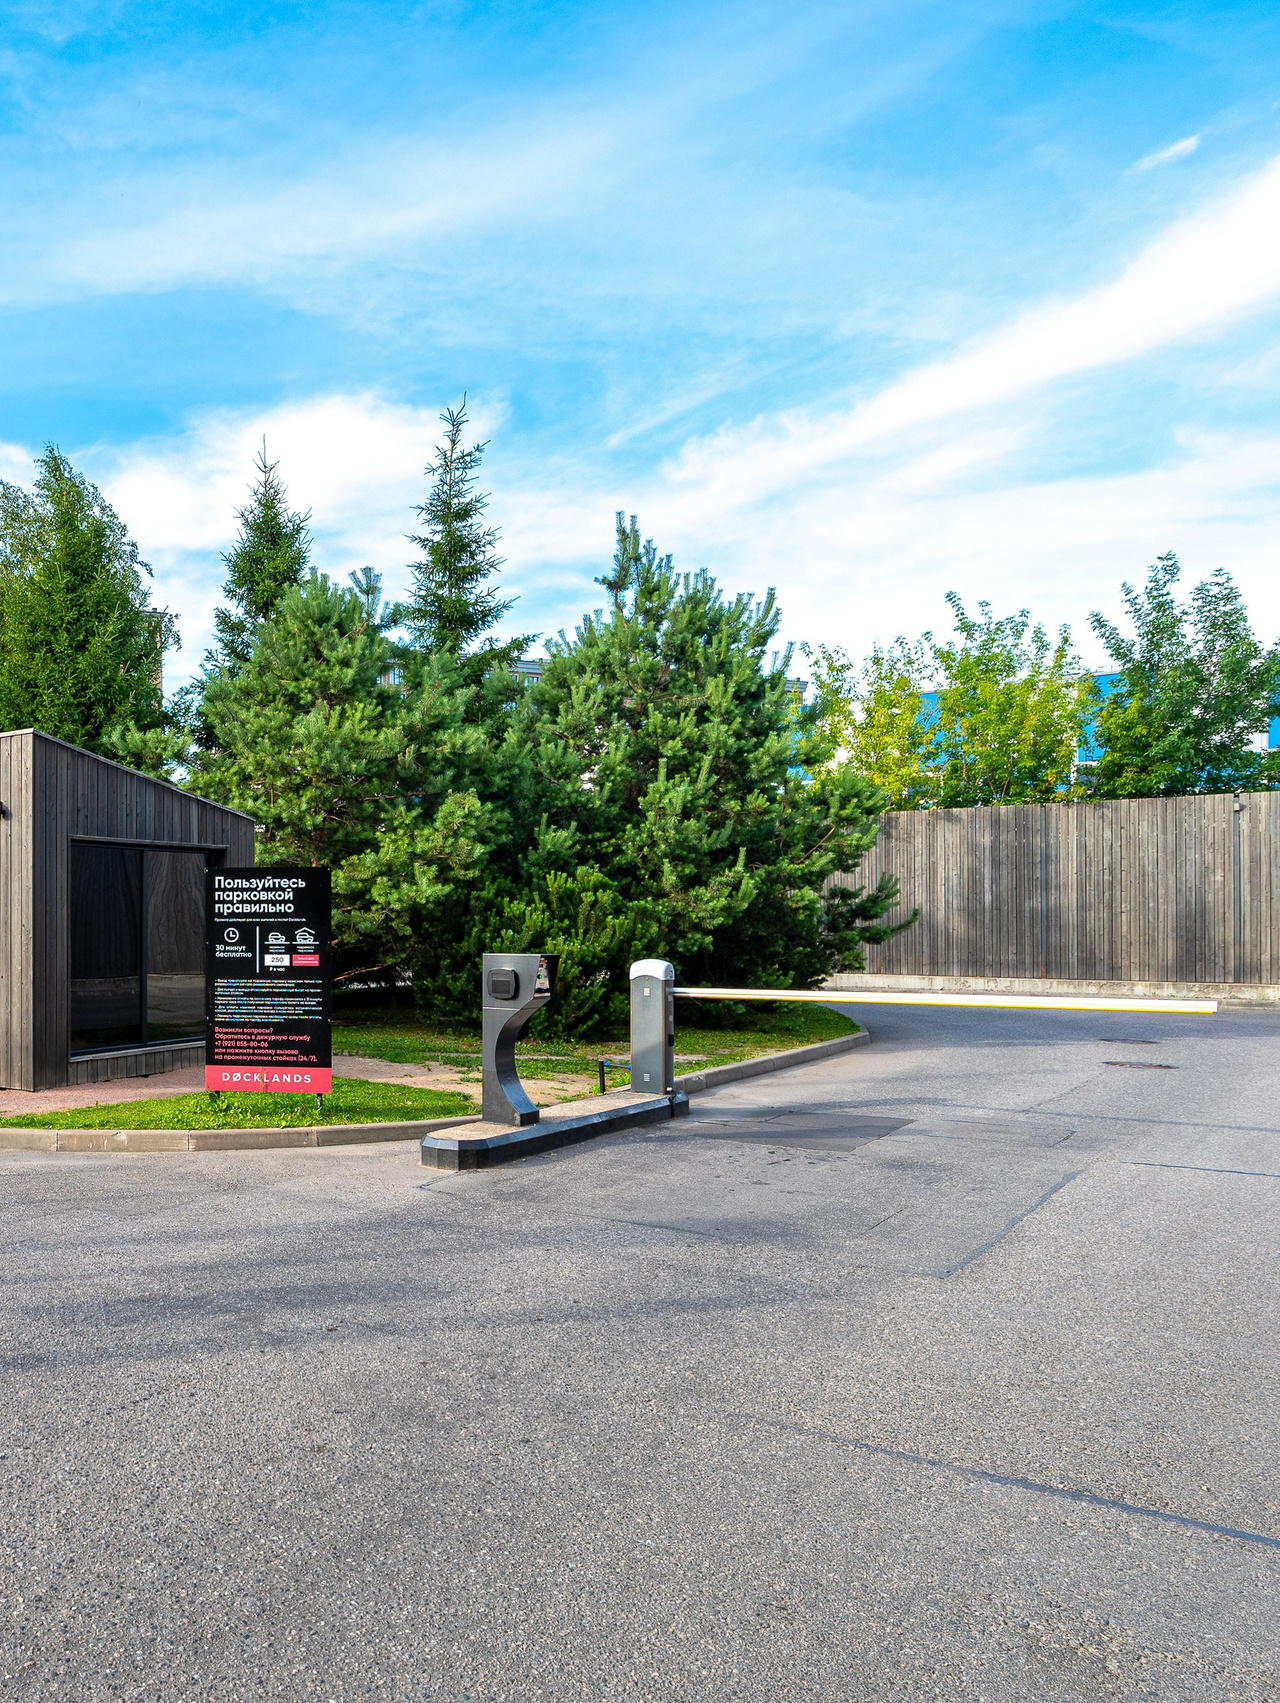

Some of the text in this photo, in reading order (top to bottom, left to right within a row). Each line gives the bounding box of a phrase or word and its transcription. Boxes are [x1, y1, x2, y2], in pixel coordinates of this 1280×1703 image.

[215, 876, 306, 891] Пользуйтесь
[215, 888, 294, 903] парковкой
[215, 903, 295, 916] правильно
[225, 945, 246, 953] минут
[222, 1072, 312, 1083] DØCKLANDS
